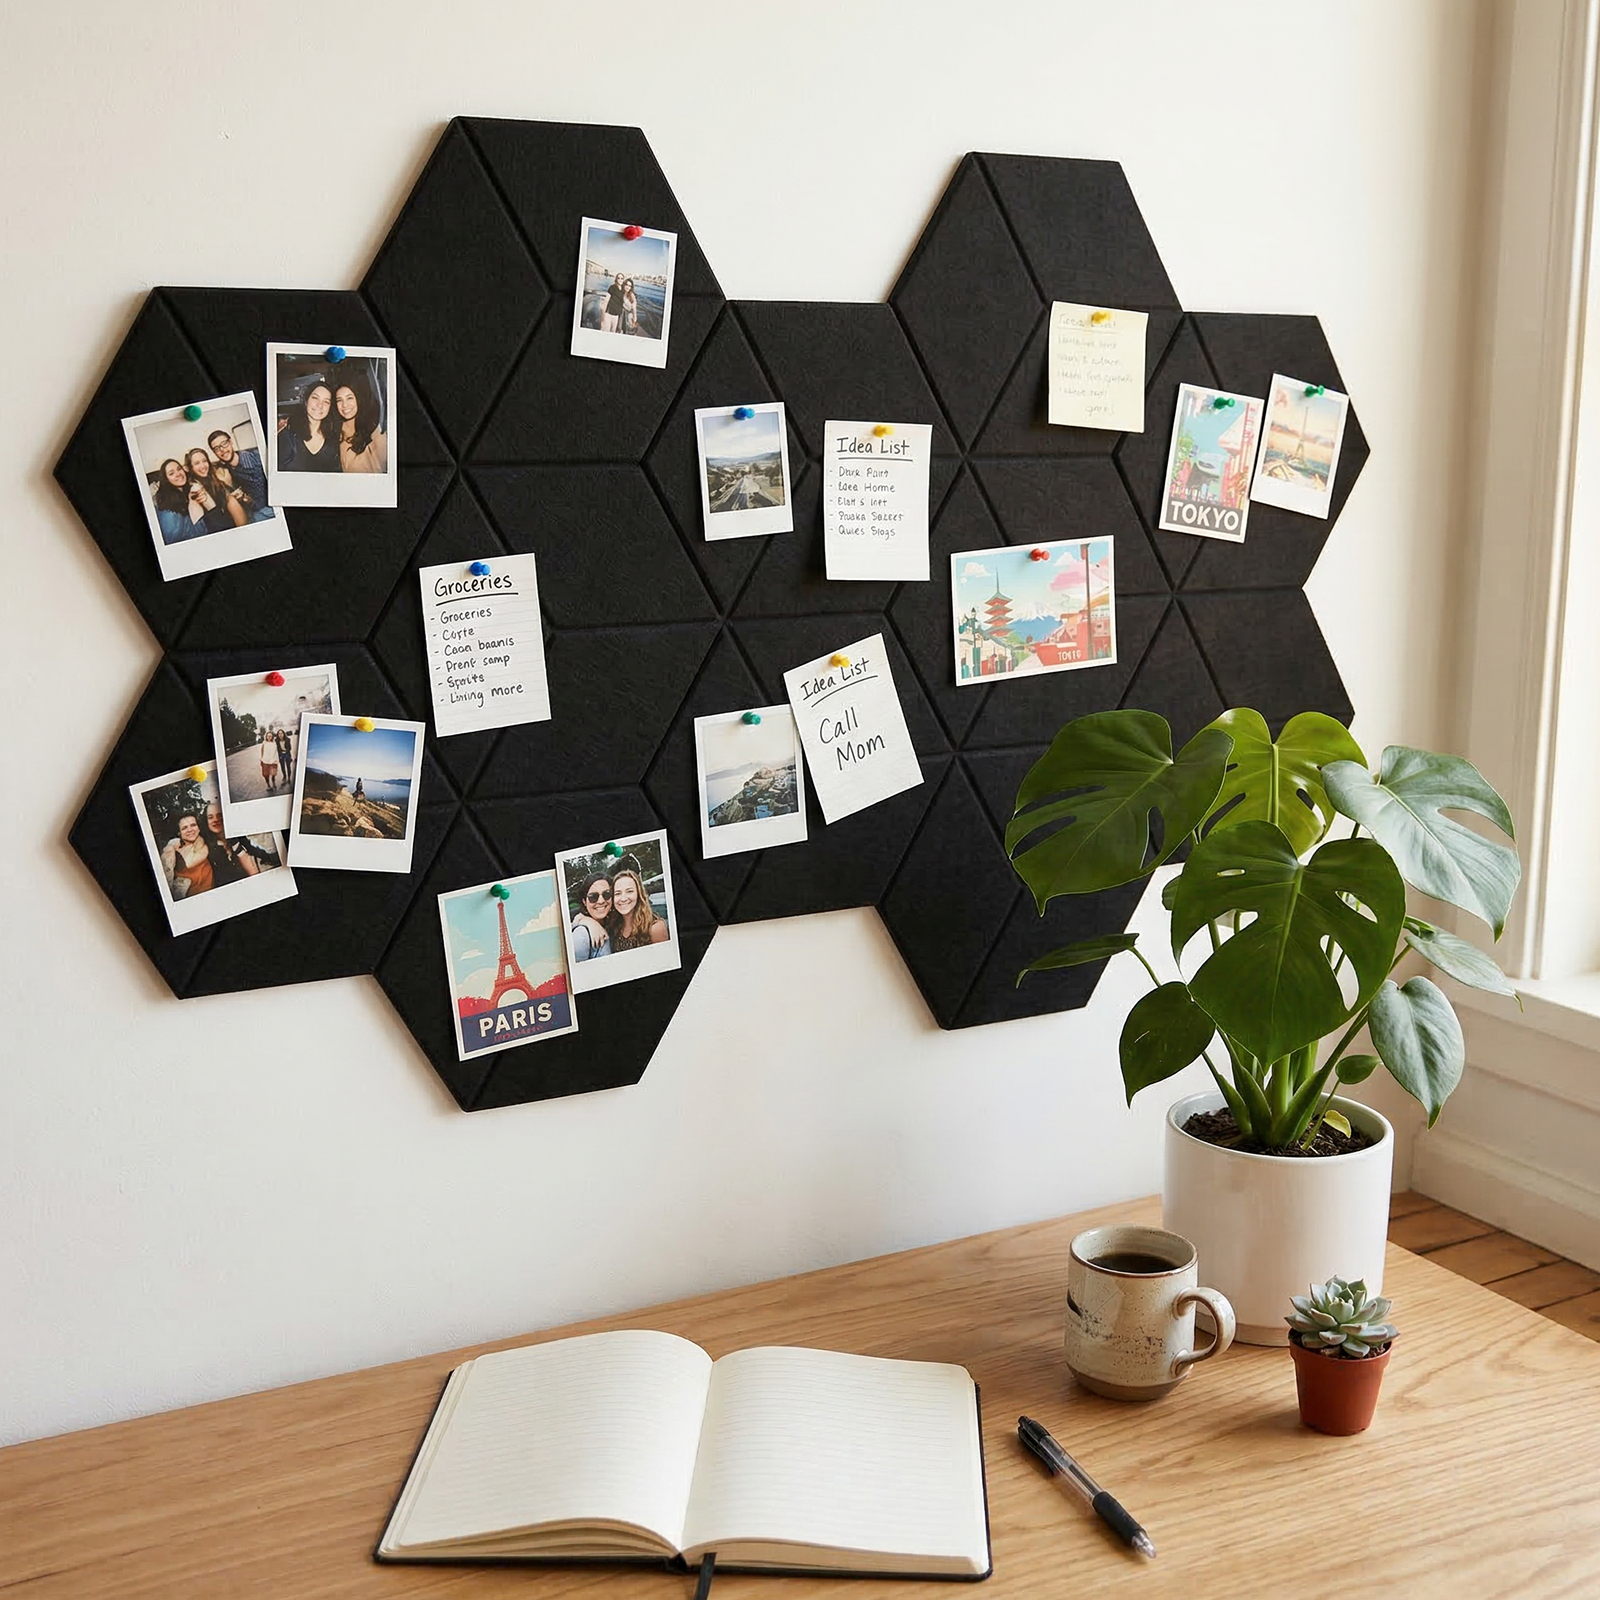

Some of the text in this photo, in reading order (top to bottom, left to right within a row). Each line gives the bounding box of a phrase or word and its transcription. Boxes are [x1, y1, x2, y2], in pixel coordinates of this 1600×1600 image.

[837, 437, 910, 455] Idea List
[1171, 501, 1239, 530] TOKYO
[434, 575, 512, 597] Groceries
[440, 608, 492, 624] Groceries
[800, 658, 870, 701] Idea List
[819, 707, 858, 744] Call
[837, 735, 885, 771] Mom
[479, 1002, 552, 1038] PARIS
